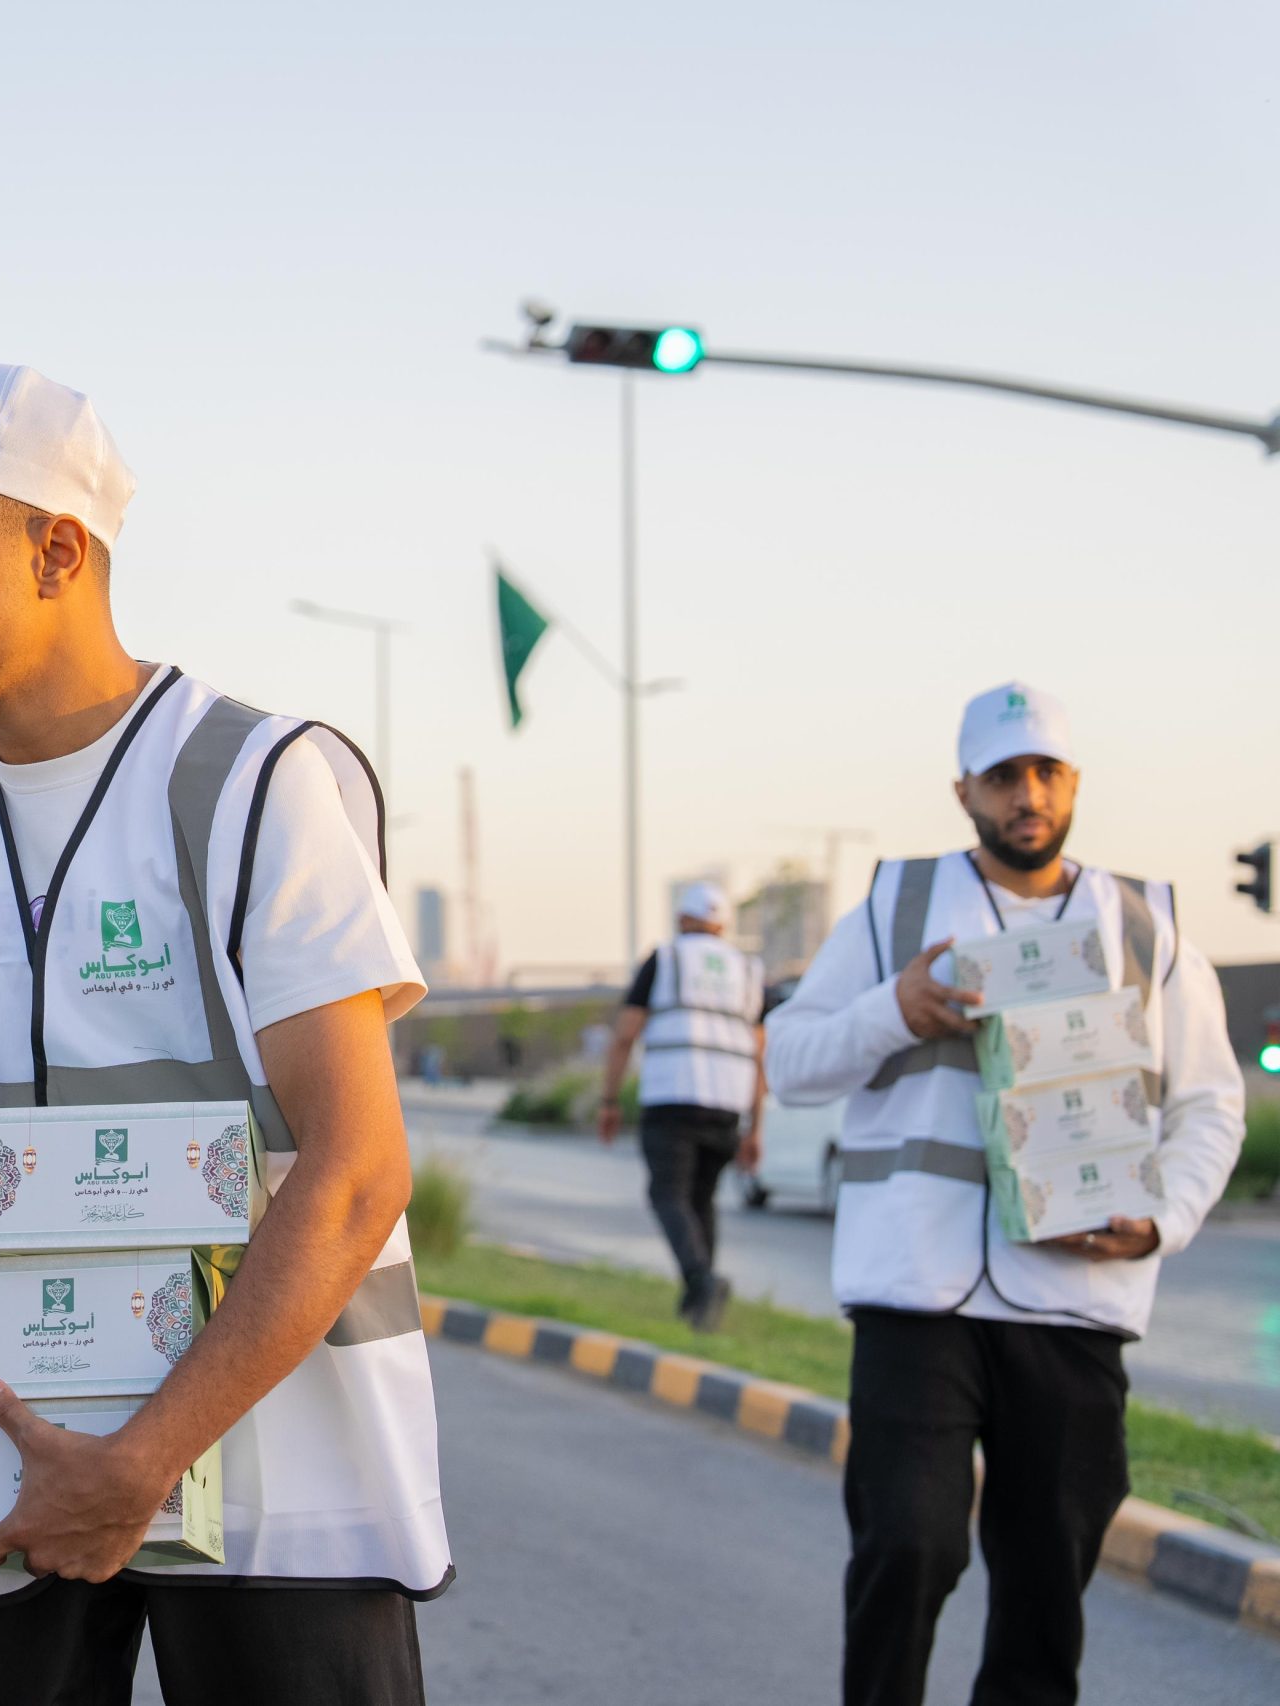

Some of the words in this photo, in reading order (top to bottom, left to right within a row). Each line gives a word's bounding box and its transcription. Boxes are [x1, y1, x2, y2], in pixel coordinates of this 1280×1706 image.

[79, 942, 171, 980] أبوكاس
[118, 981, 133, 995] في
[162, 976, 175, 991] في
[74, 1162, 149, 1186] أبوكاس
[103, 1187, 115, 1197] في
[136, 1187, 149, 1196] في
[22, 1311, 94, 1337] أبوكاس
[50, 1338, 62, 1348] في
[82, 1336, 94, 1346] في
